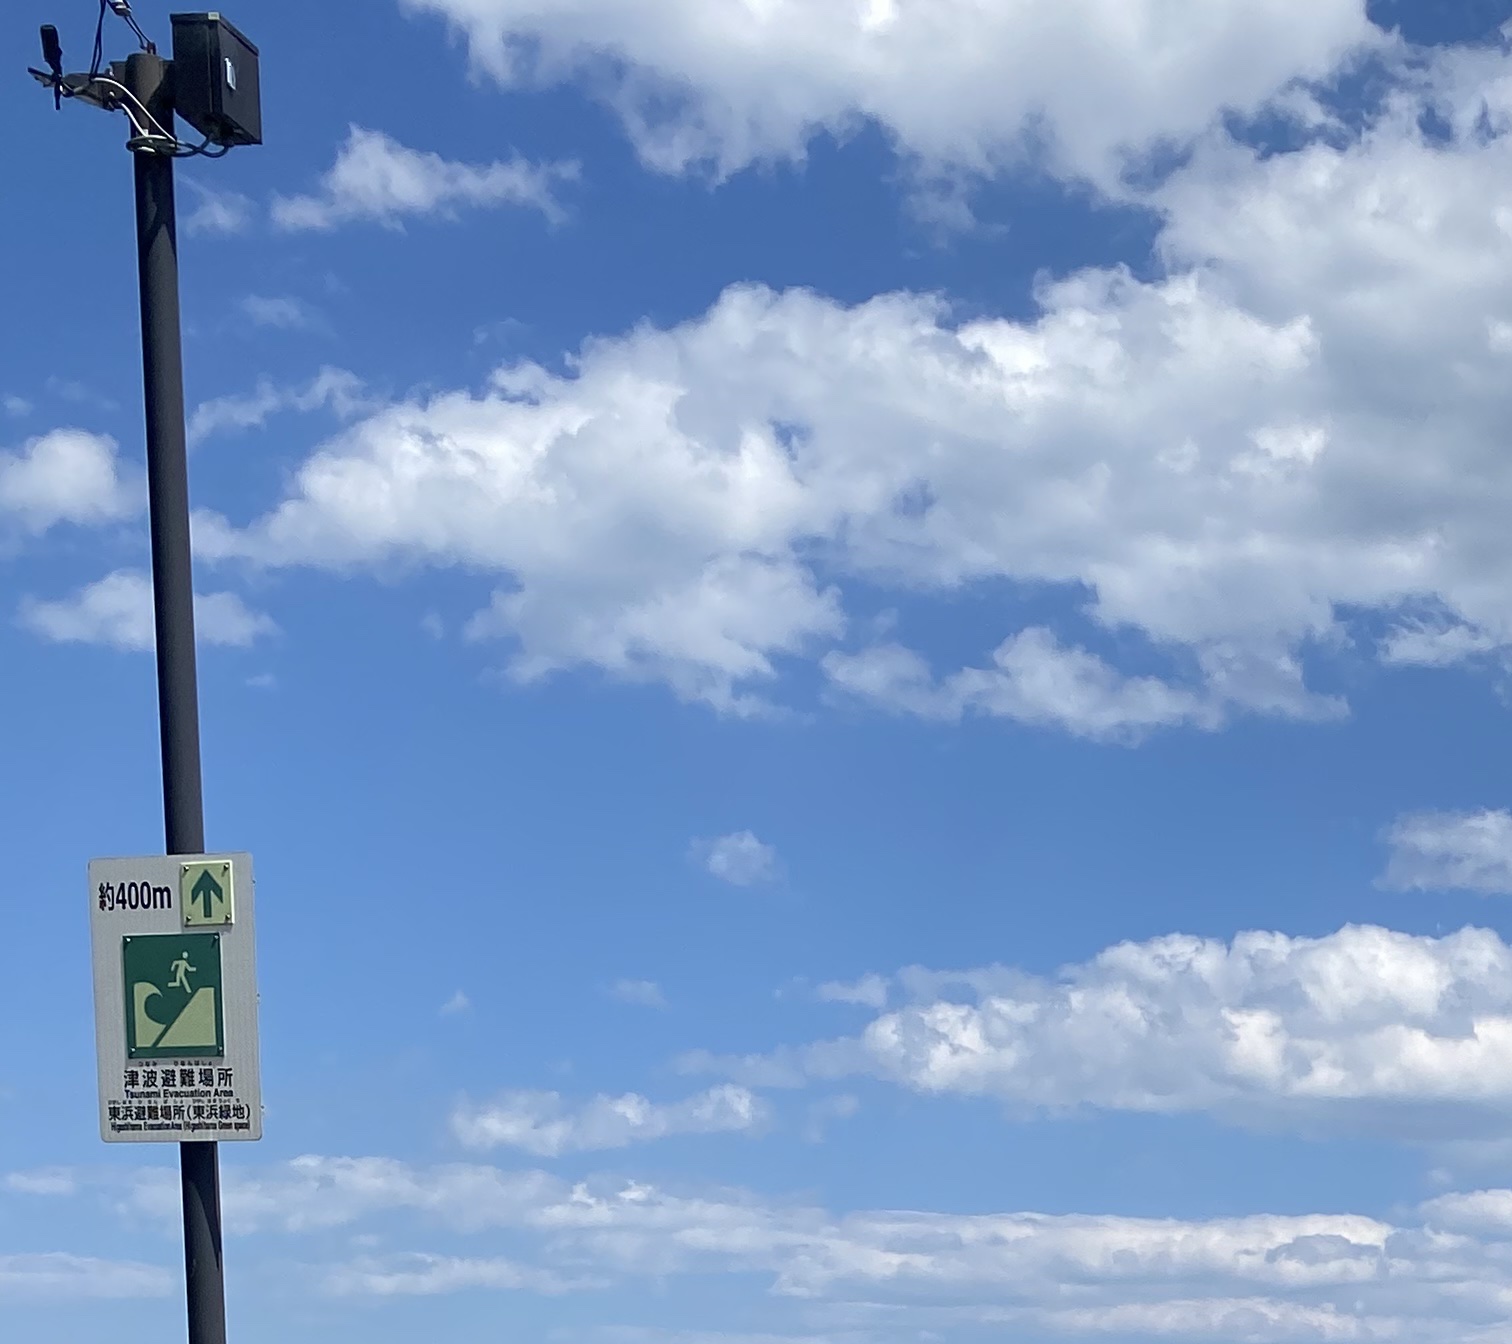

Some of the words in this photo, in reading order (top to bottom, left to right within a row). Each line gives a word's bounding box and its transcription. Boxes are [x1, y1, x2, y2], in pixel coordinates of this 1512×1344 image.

[98, 881, 172, 911] 約400m
[123, 1068, 233, 1089] 津波避難場所
[124, 1089, 160, 1099] Tsunami
[163, 1089, 212, 1098] Evacuation
[213, 1088, 234, 1098] Area
